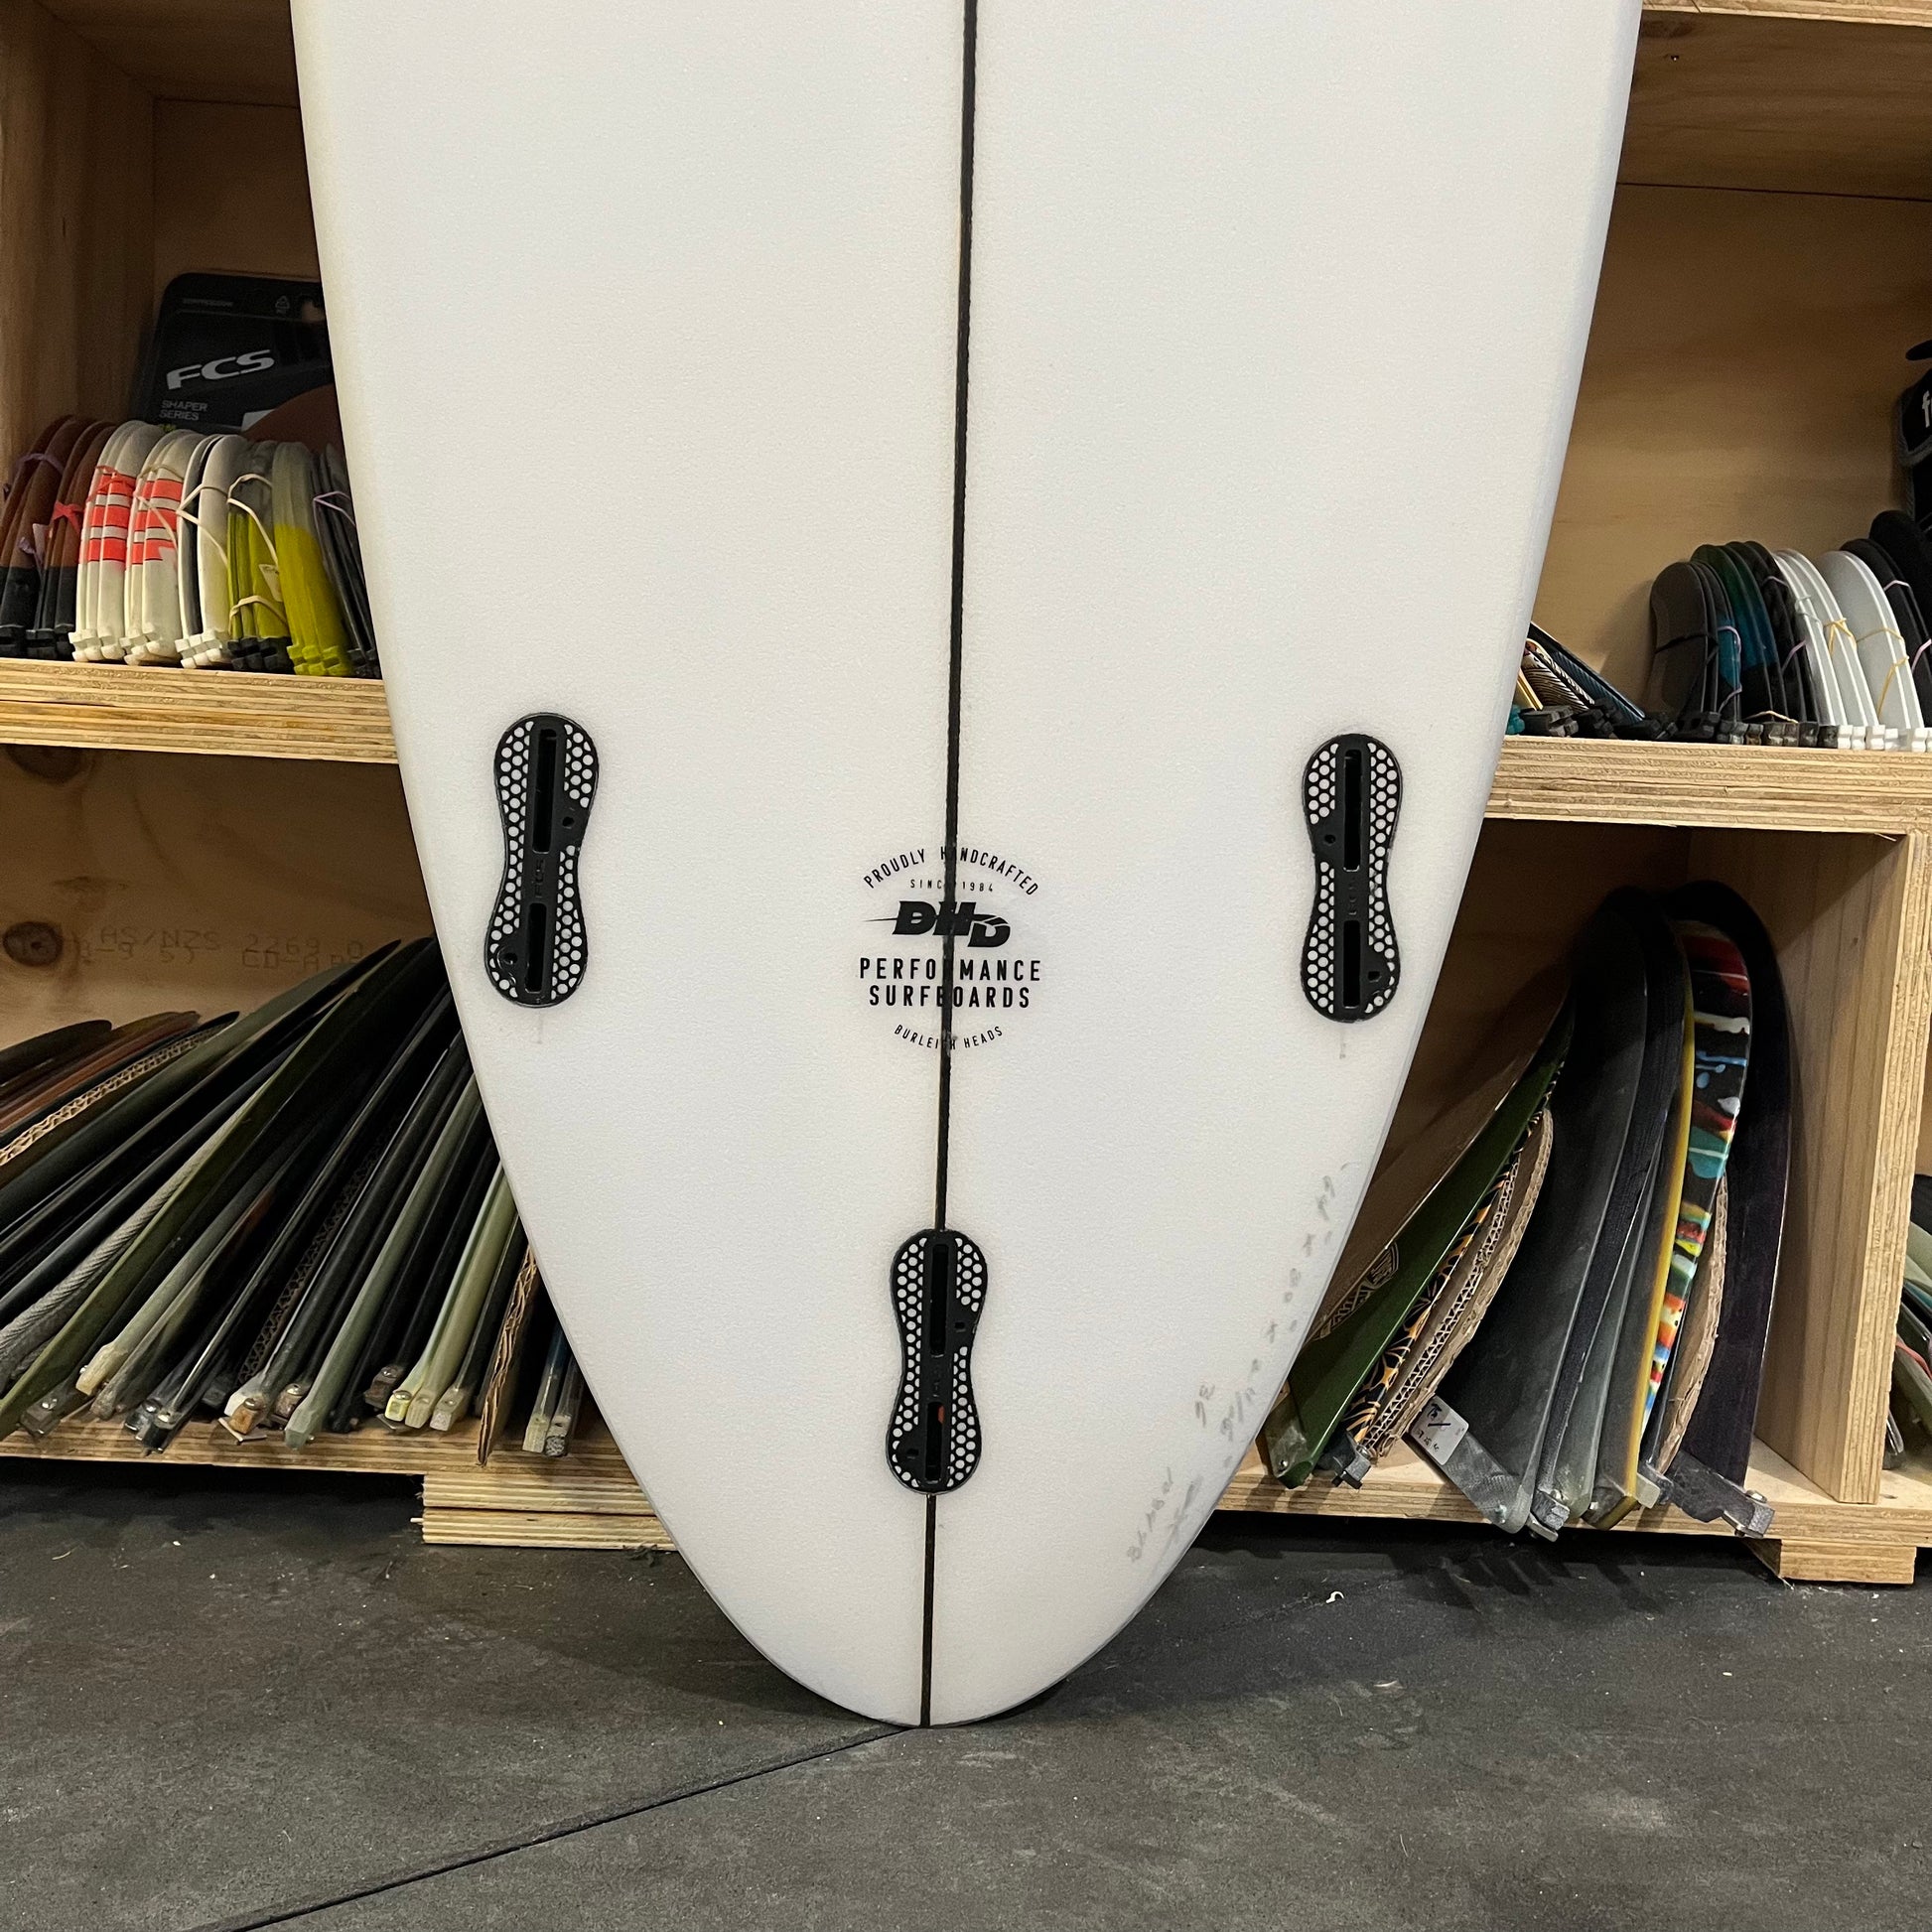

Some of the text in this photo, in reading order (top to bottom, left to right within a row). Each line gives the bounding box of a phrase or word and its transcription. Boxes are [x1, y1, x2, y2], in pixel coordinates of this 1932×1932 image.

[167, 349, 275, 390] FCS
[159, 409, 201, 422] SERIES
[161, 399, 208, 412] SHAPER
[863, 846, 1039, 896] PROUDLY HNDCRAFTED
[909, 879, 994, 892] SINC 1984
[892, 899, 1011, 948] DHD
[859, 957, 1041, 981] PERFOMANCE
[894, 1024, 1003, 1050] BURLEIH HEADS
